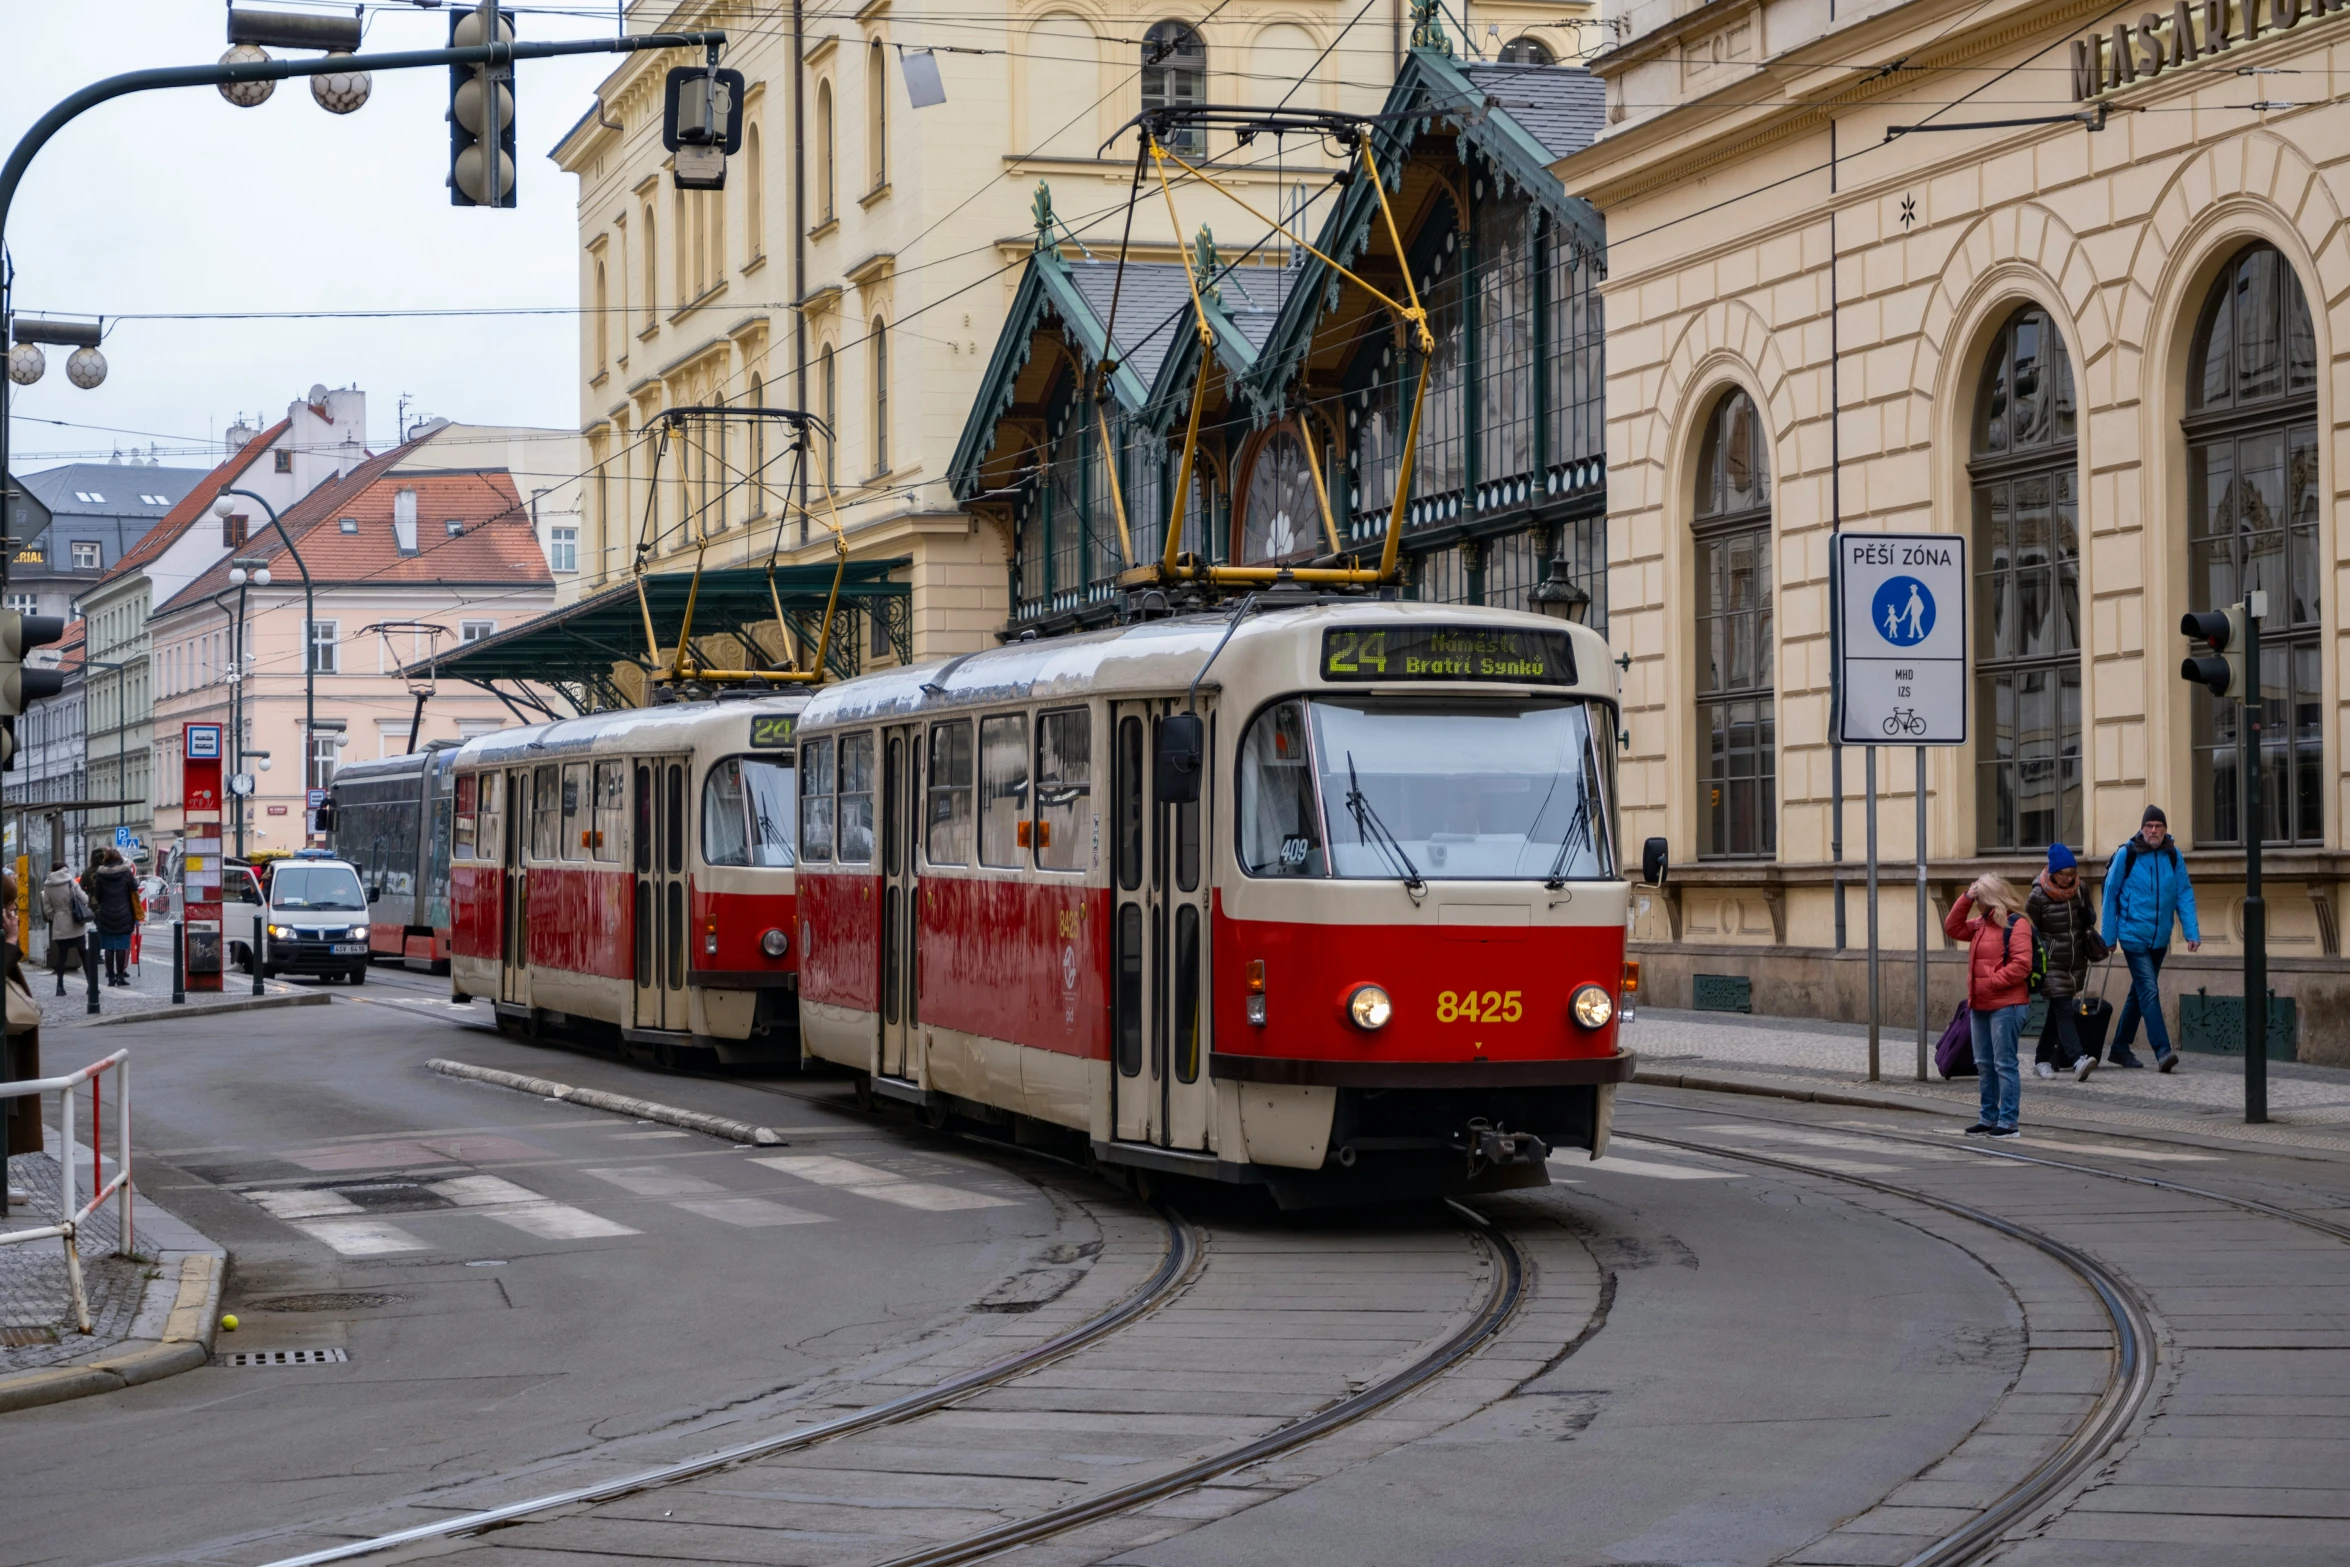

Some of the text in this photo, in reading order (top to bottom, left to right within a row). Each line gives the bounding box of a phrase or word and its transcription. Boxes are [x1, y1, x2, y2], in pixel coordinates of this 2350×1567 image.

[1853, 543, 1952, 566] PĚŠÍ ZÓNA
[1329, 631, 1387, 673] 24
[1431, 632, 1518, 653] Náměstí
[1406, 654, 1544, 675] Bratří Synků
[1895, 669, 1914, 680] MHD
[1898, 686, 1911, 697] IZS
[755, 718, 791, 743] 24
[118, 829, 127, 841] P
[1280, 838, 1309, 862] 409
[1060, 909, 1079, 939] 8425
[1436, 990, 1523, 1023] 8425
